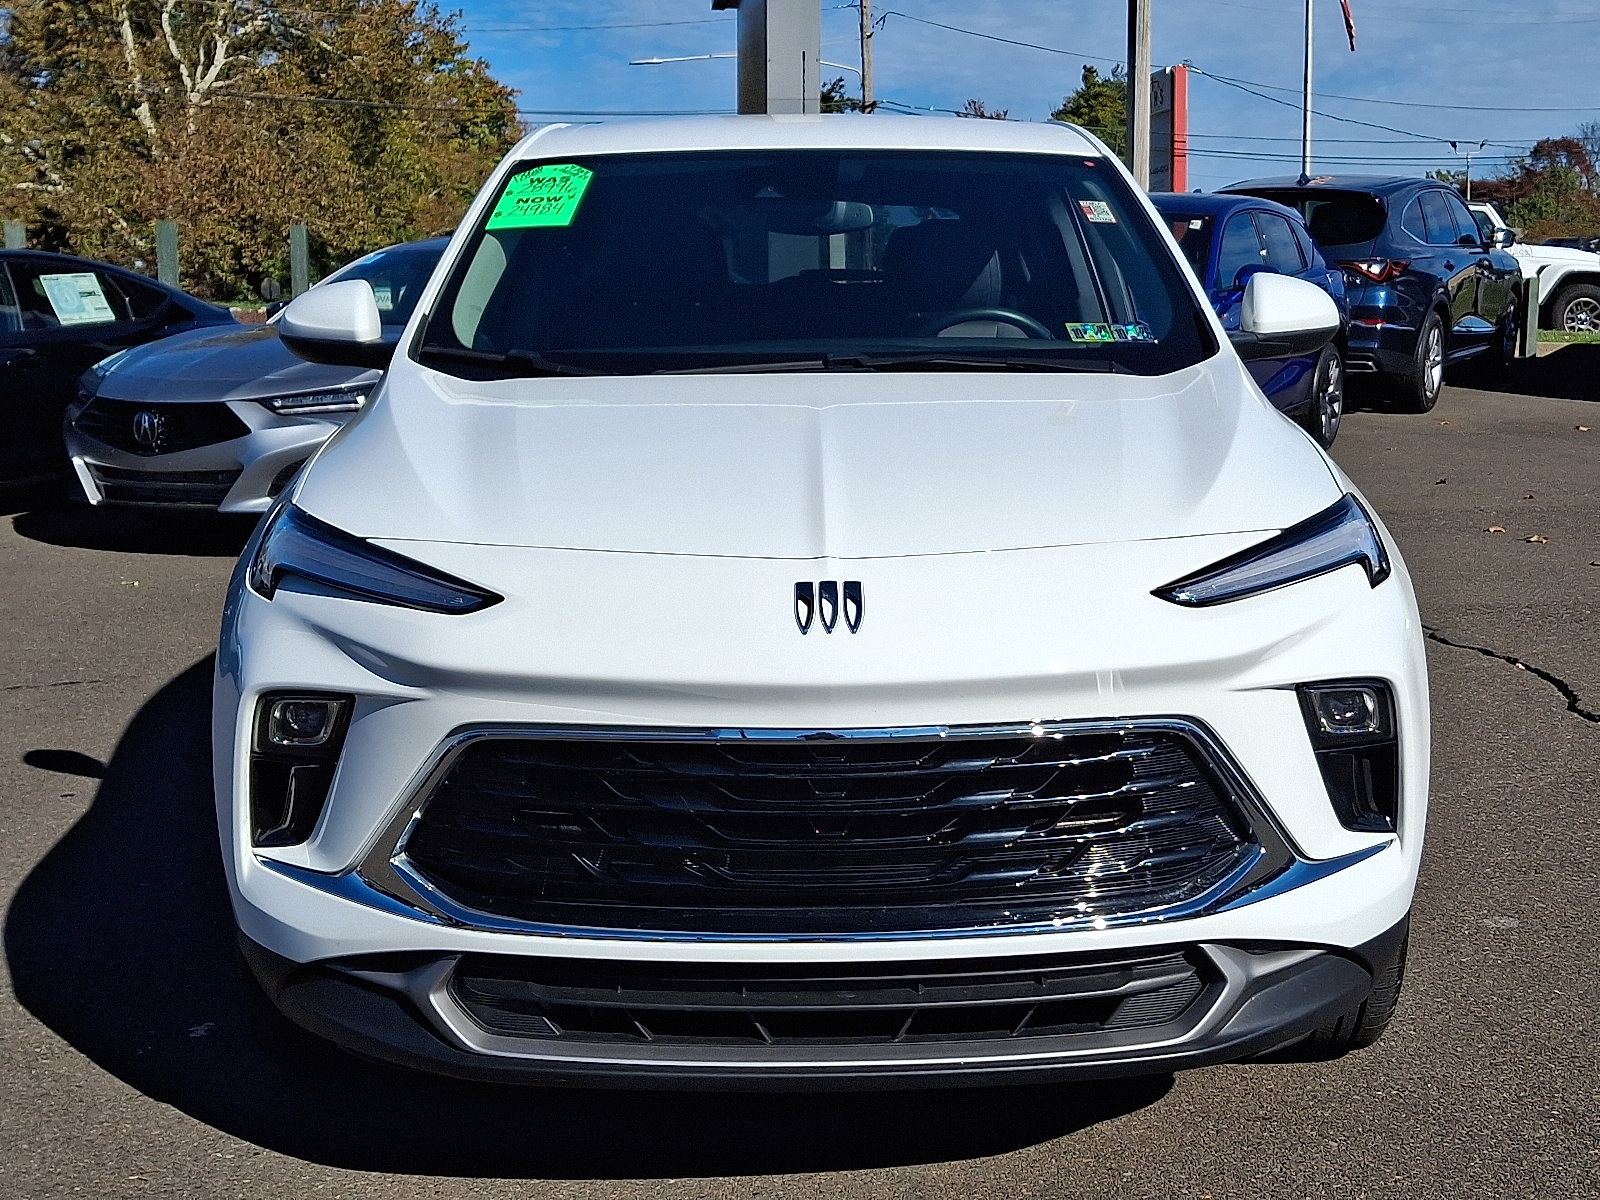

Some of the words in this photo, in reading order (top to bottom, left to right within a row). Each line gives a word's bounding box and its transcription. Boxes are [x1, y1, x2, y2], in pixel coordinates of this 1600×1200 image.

[530, 176, 571, 184] WAS
[516, 195, 563, 204] NOW
[507, 204, 565, 215] 24984
